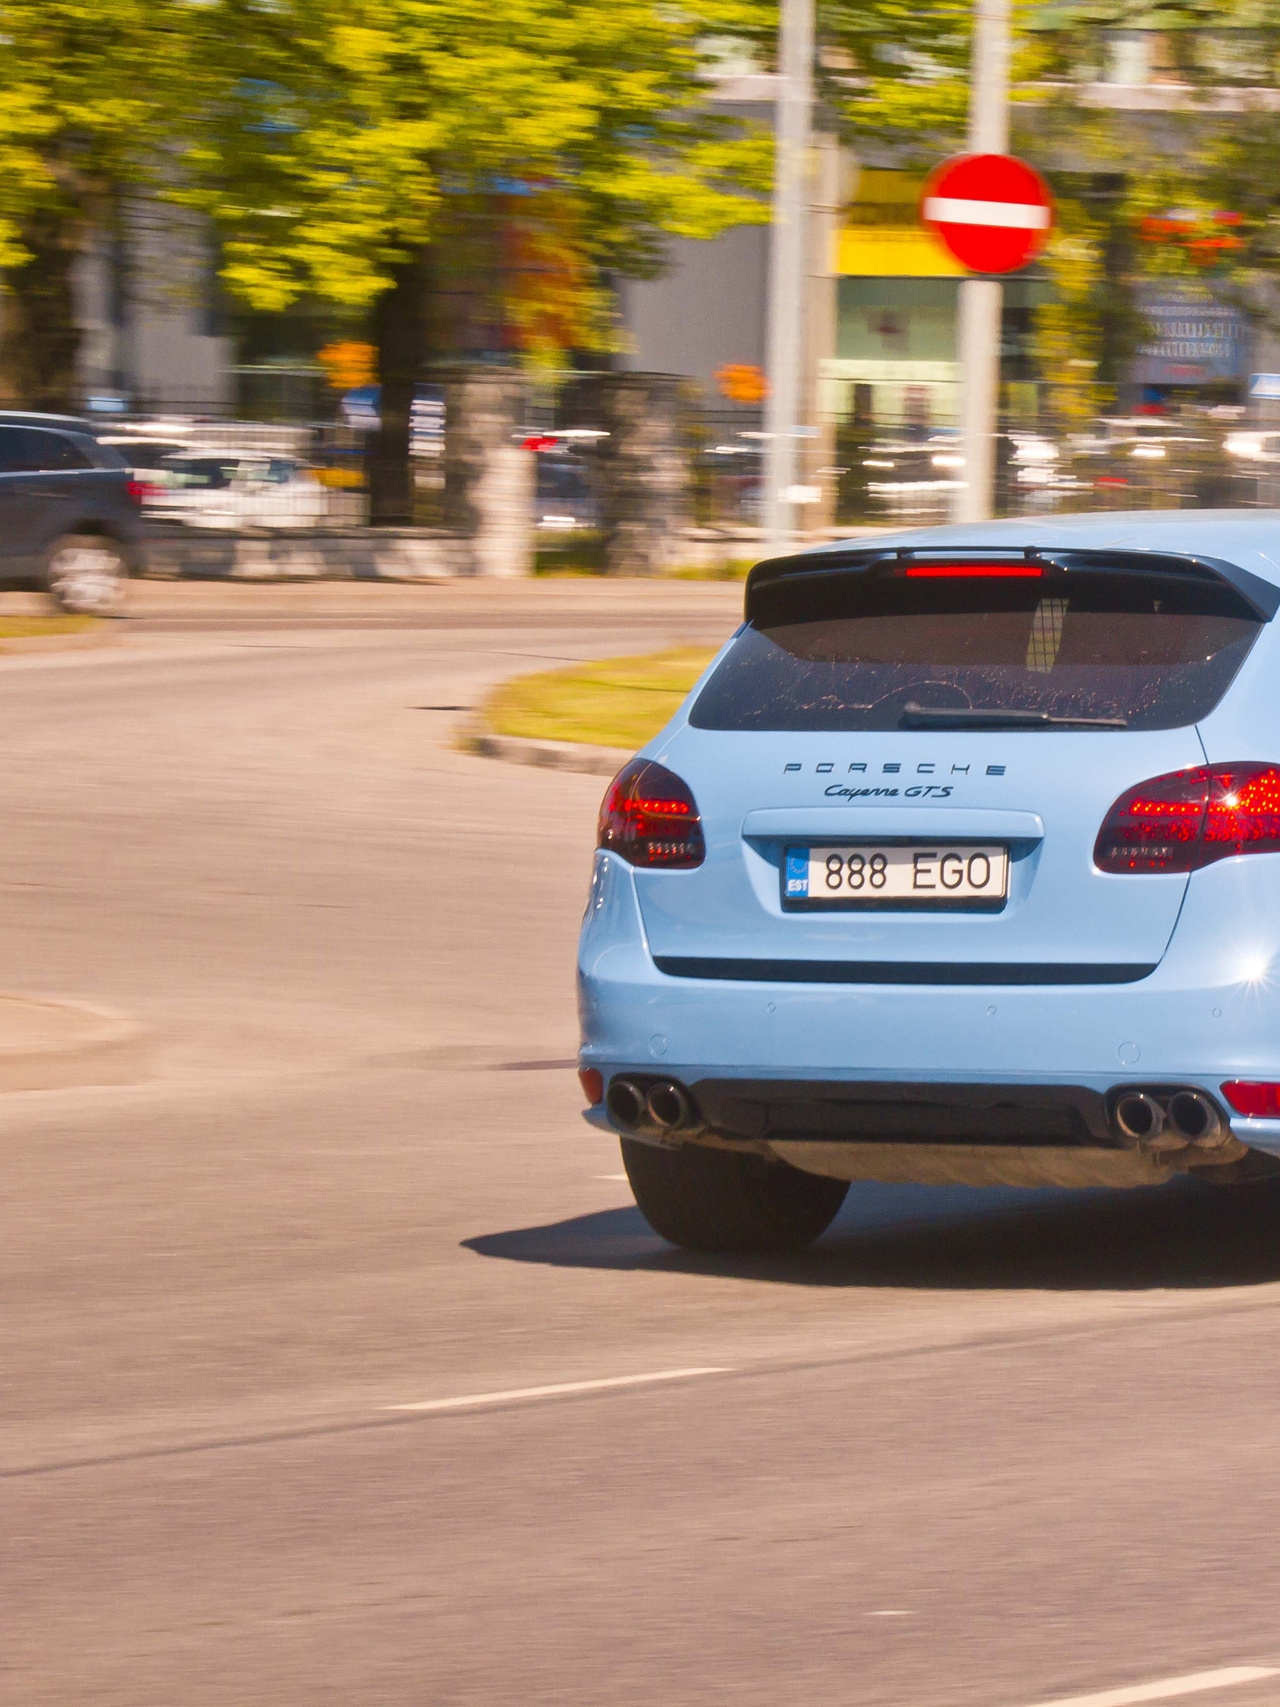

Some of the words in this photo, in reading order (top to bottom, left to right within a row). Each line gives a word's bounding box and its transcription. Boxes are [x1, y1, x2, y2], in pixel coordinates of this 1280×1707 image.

[783, 762, 1007, 776] PORSCHE
[824, 783, 900, 802] Cayenne
[904, 785, 954, 798] GTS
[825, 853, 888, 890] 888
[912, 851, 991, 890] EGO
[787, 878, 809, 892] EST
